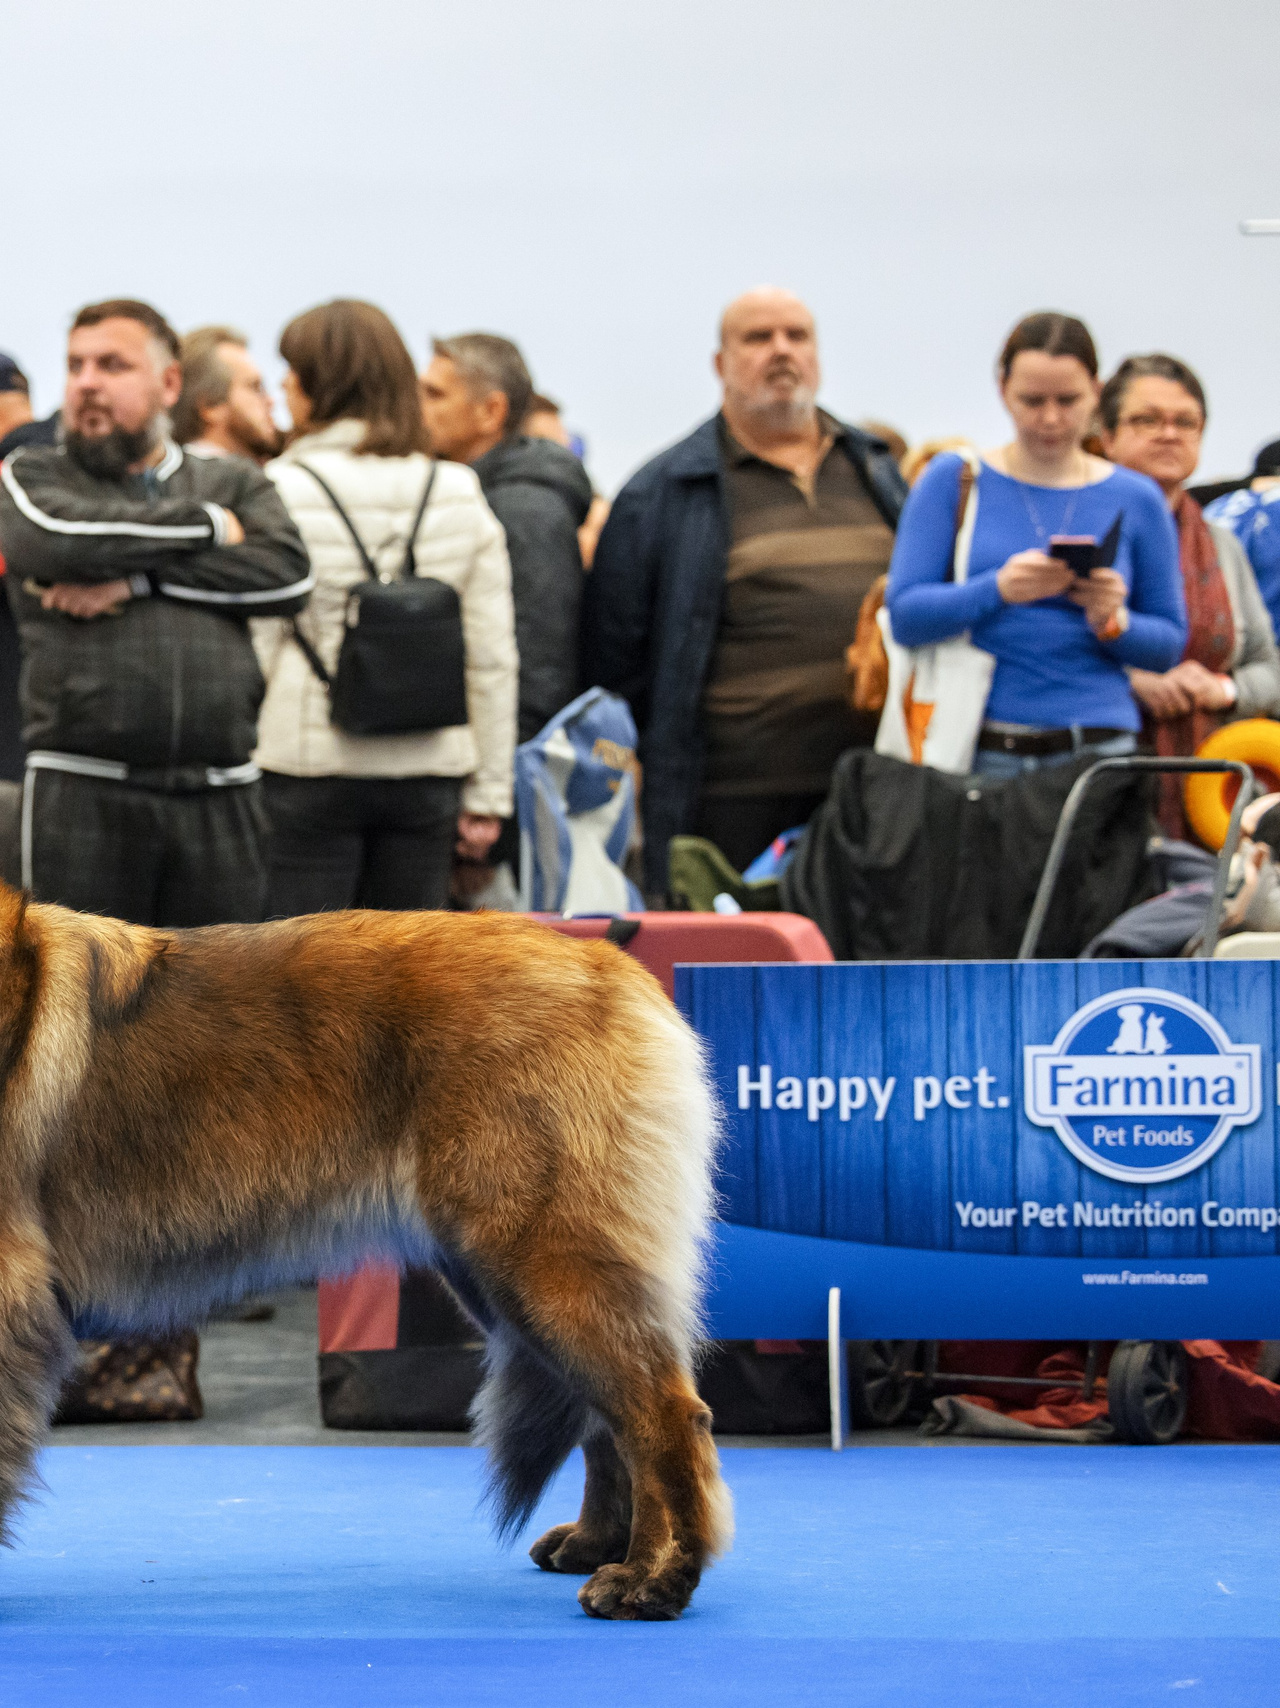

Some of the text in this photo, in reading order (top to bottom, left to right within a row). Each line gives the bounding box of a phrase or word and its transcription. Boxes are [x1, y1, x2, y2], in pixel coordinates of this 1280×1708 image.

[738, 1064, 1009, 1121] Happy pet.
[1049, 1064, 1235, 1106] Farmina
[1093, 1125, 1194, 1147] Pet Foods
[955, 1200, 1280, 1233] Your Pet Nutrition Comp
[1082, 1270, 1208, 1285] www.Farmina.com
